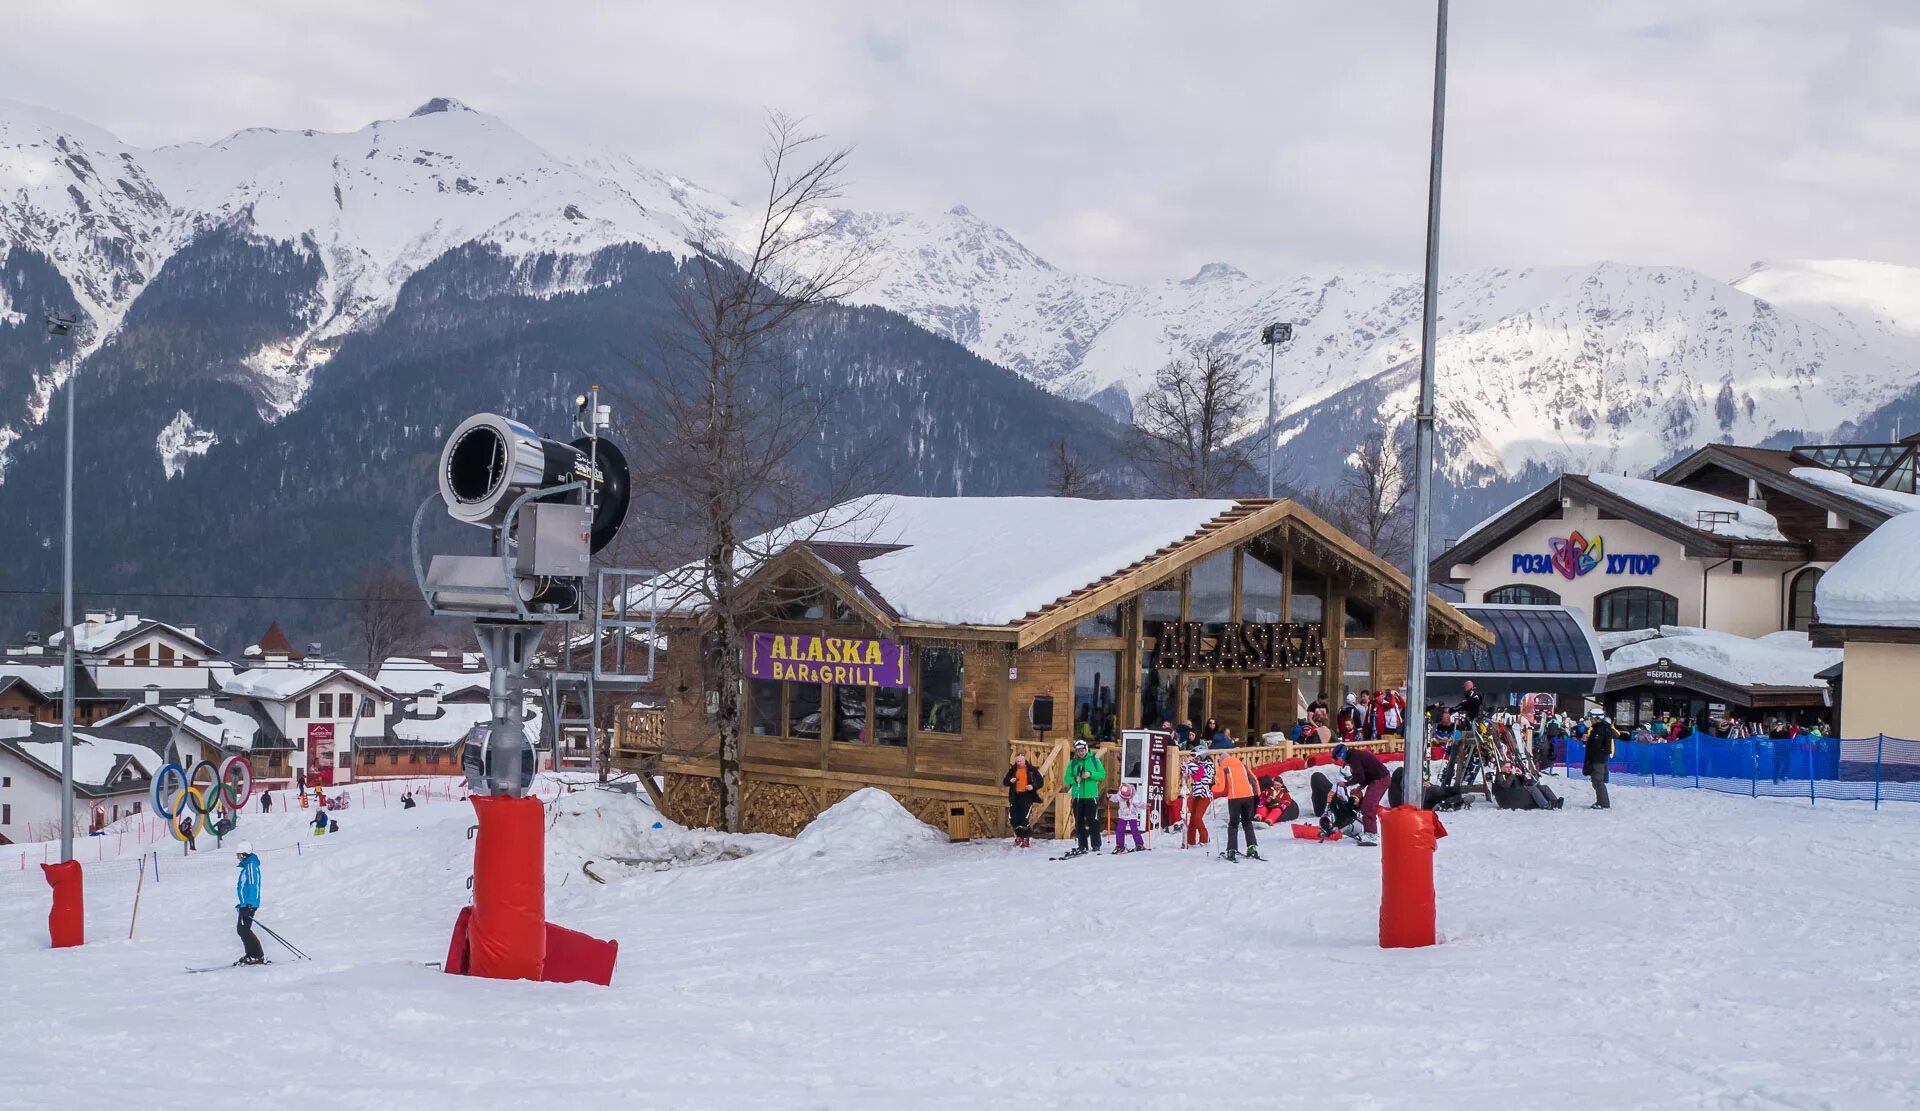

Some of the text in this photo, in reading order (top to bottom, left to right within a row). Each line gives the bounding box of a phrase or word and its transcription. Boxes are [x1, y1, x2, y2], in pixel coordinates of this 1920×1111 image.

[1512, 554, 1660, 575] РОЗА ХУТОР
[770, 635, 884, 666] ALASKA
[1154, 621, 1327, 670] ALASKA
[773, 661, 879, 686] BAR&GRILL
[1651, 670, 1678, 679] БЕРЛОГА
